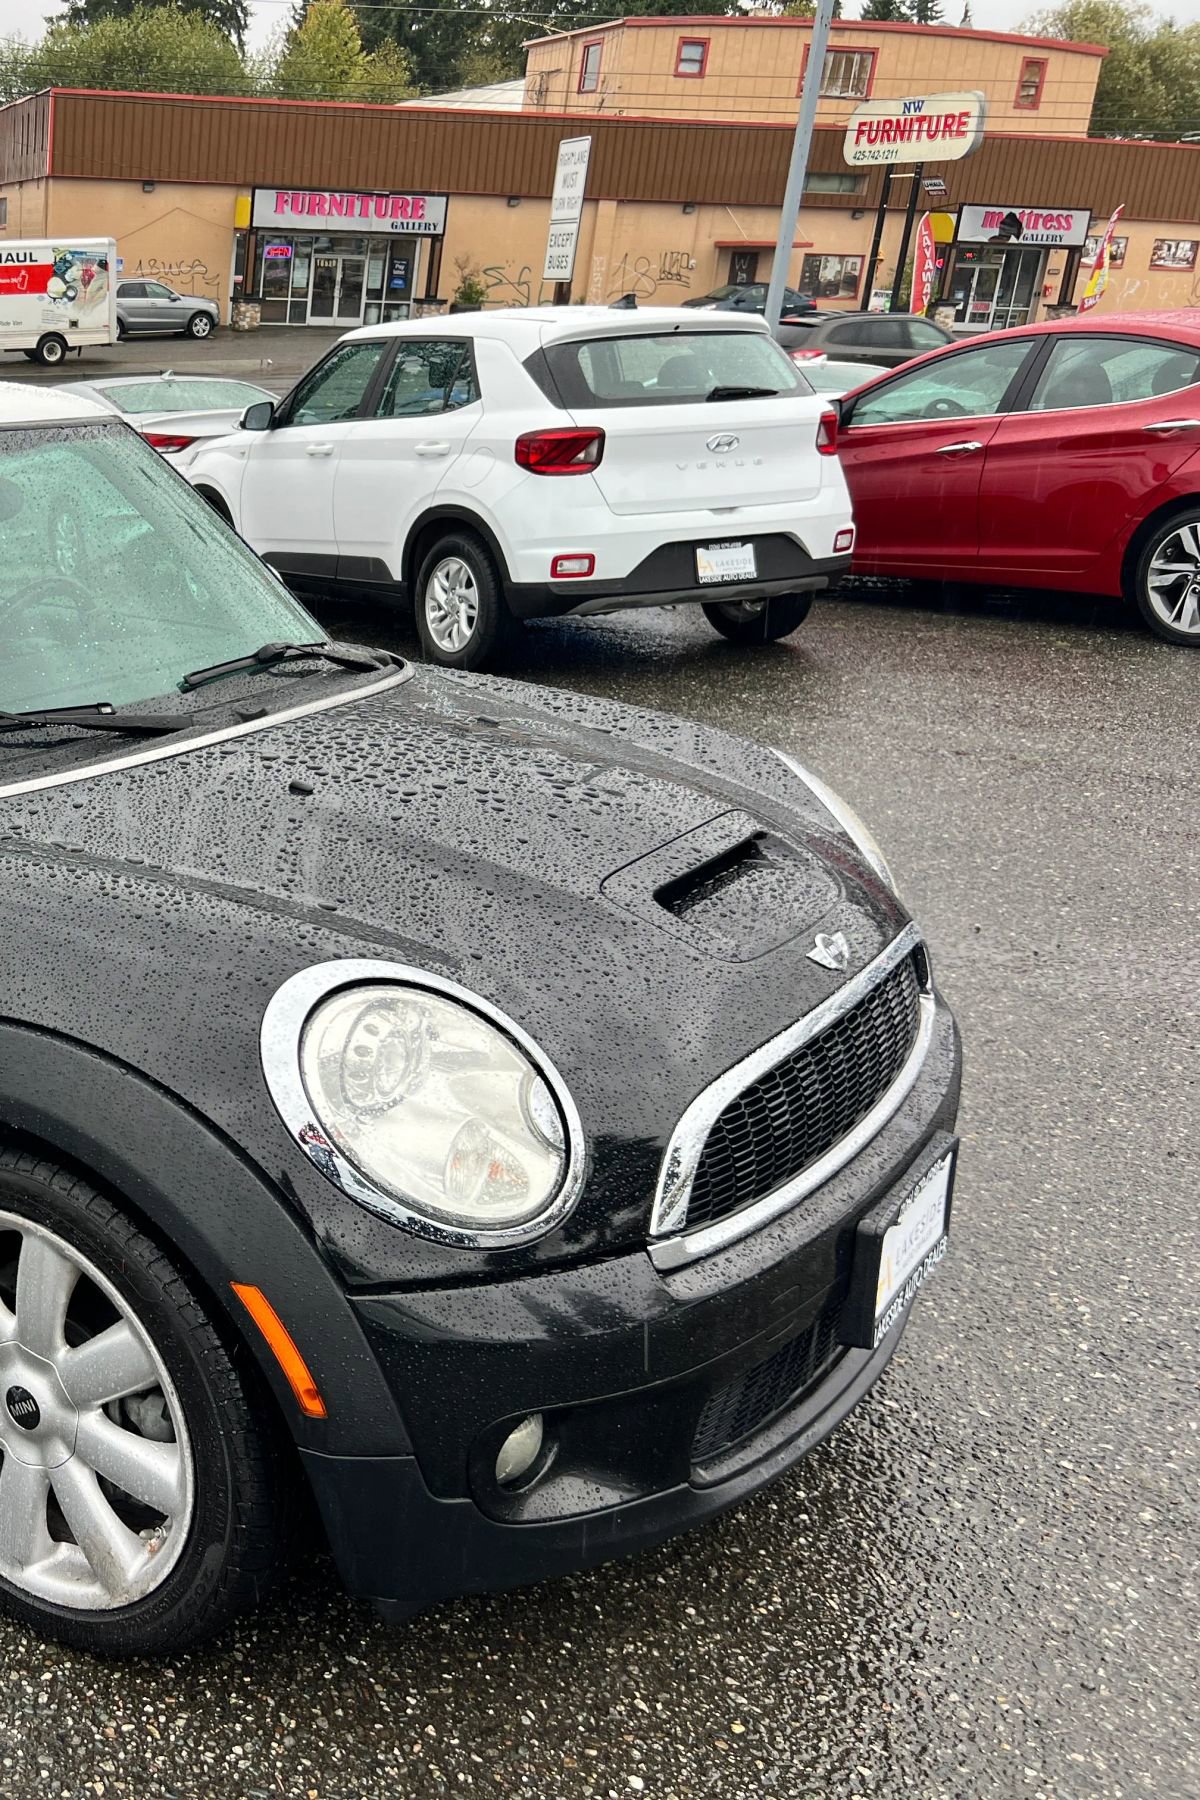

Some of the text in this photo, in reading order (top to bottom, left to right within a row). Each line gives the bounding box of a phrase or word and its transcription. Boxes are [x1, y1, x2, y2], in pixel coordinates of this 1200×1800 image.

[903, 100, 925, 114] NW
[855, 111, 971, 146] FURNITURE
[853, 149, 899, 161] 425-742-1211
[562, 171, 578, 188] MUST
[274, 191, 426, 220] FURNITURE
[391, 221, 439, 232] GALLERY
[981, 209, 1074, 231] mttress
[549, 232, 573, 248] EXCEPT
[1022, 232, 1064, 243] GALLERY
[548, 255, 568, 269] BUSES
[922, 224, 934, 306] LAYAWAY
[716, 558, 753, 568] LAKESIDE
[874, 1236, 948, 1348] LAKESIDE AUTO DEALER
[10, 1399, 37, 1417] MINI
